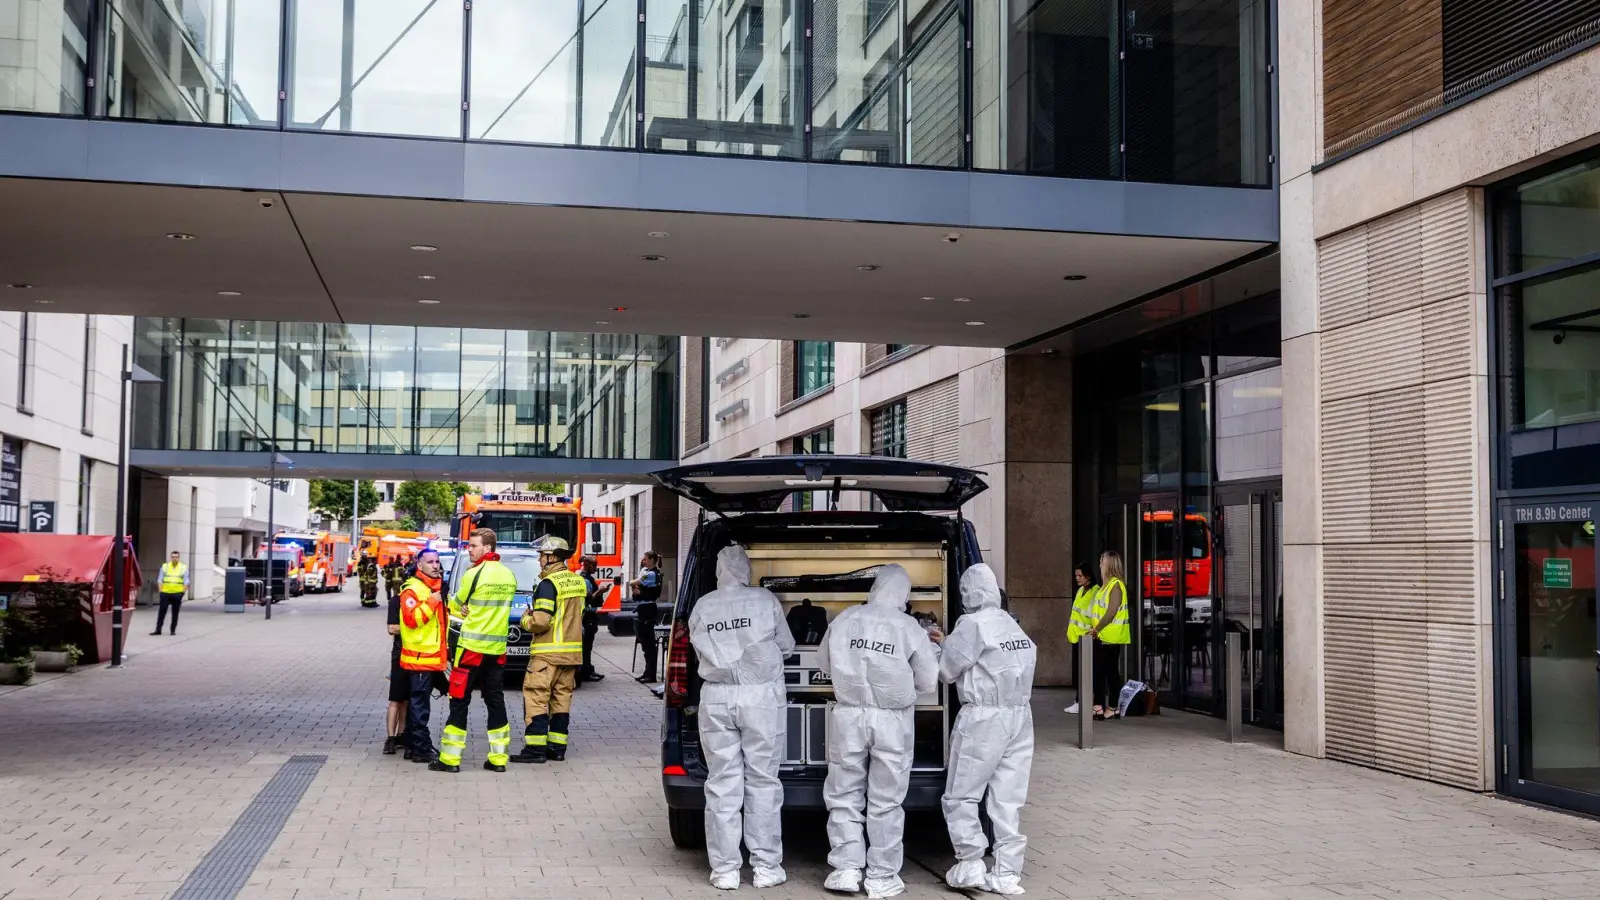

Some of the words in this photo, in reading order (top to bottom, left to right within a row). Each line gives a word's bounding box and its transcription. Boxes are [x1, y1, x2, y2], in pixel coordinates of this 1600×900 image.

[502, 494, 553, 502] FEUERWEHR
[1516, 508, 1533, 521] TRH
[1536, 507, 1556, 520] 8.9b
[1559, 506, 1591, 520] Center
[595, 567, 613, 579] 112
[707, 617, 751, 633] POLIZEI
[850, 638, 895, 655] POLIZEI
[999, 639, 1031, 652] POIZEI
